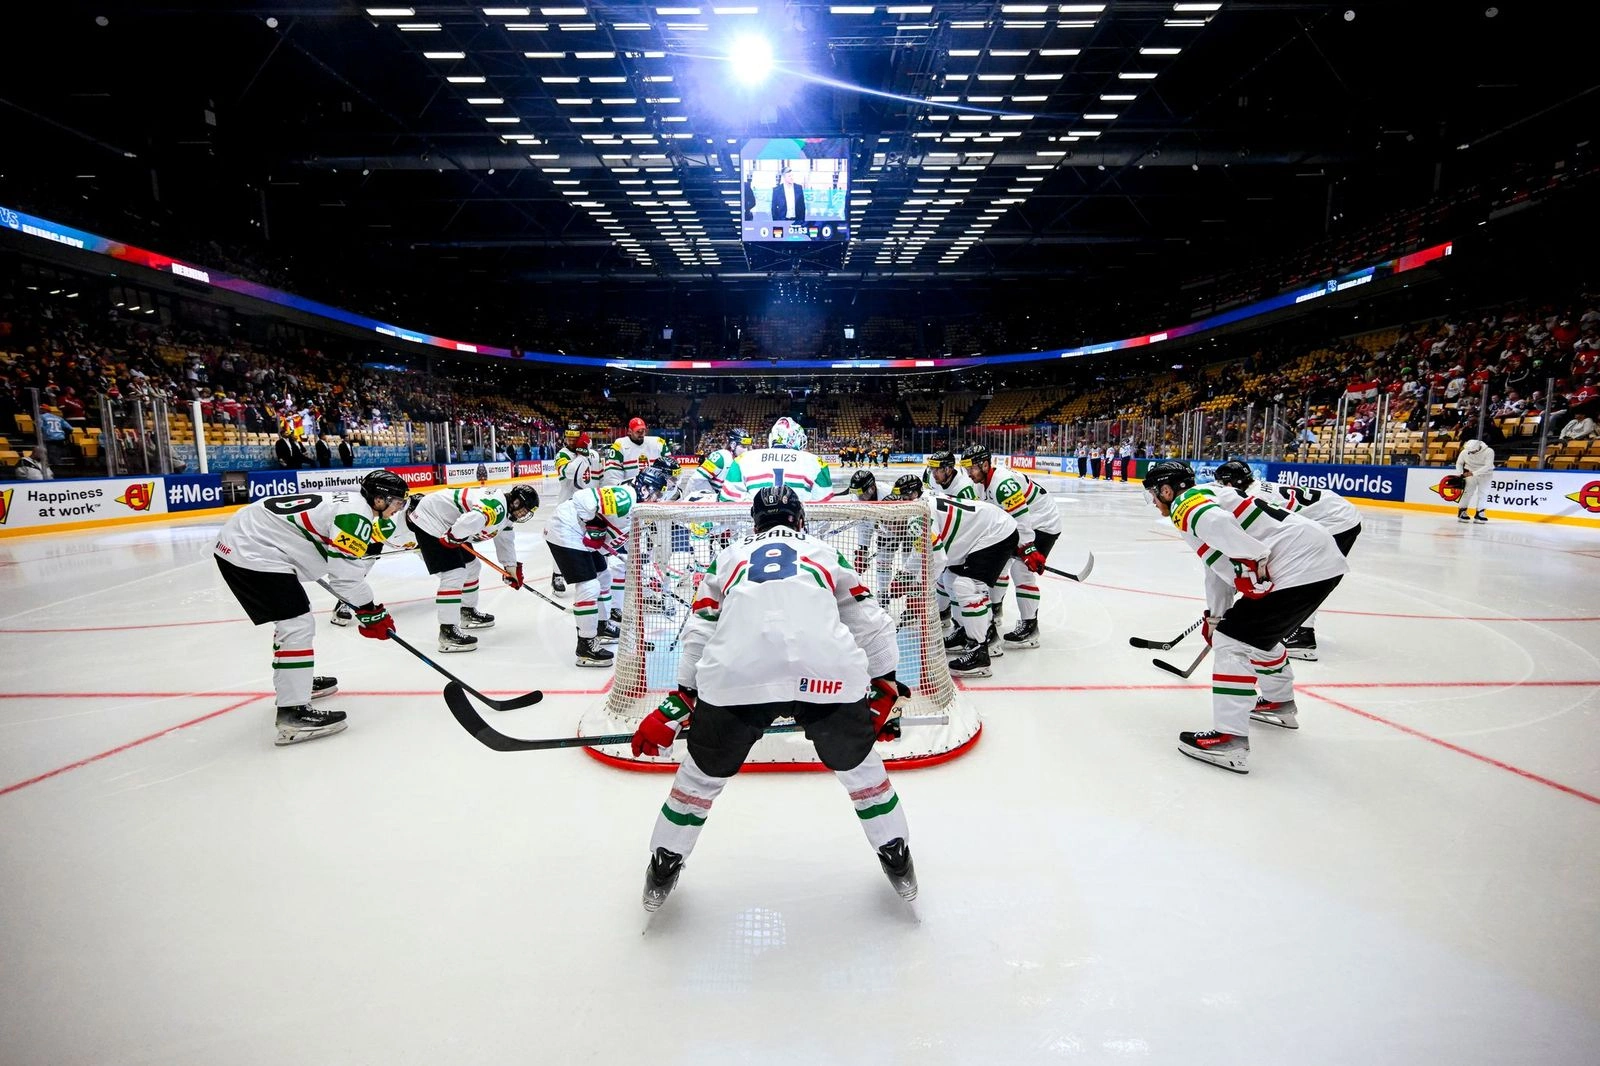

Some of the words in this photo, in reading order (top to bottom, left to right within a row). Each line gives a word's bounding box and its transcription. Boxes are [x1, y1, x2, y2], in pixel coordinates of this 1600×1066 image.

[761, 453, 797, 463] BALIZS
[999, 480, 1018, 497] 36
[1278, 471, 1392, 494] #MensWorlds
[28, 488, 103, 504] Happiness
[39, 508, 55, 517] at
[354, 518, 371, 541] 10
[747, 543, 798, 584] 8
[809, 679, 843, 694] IIHF
